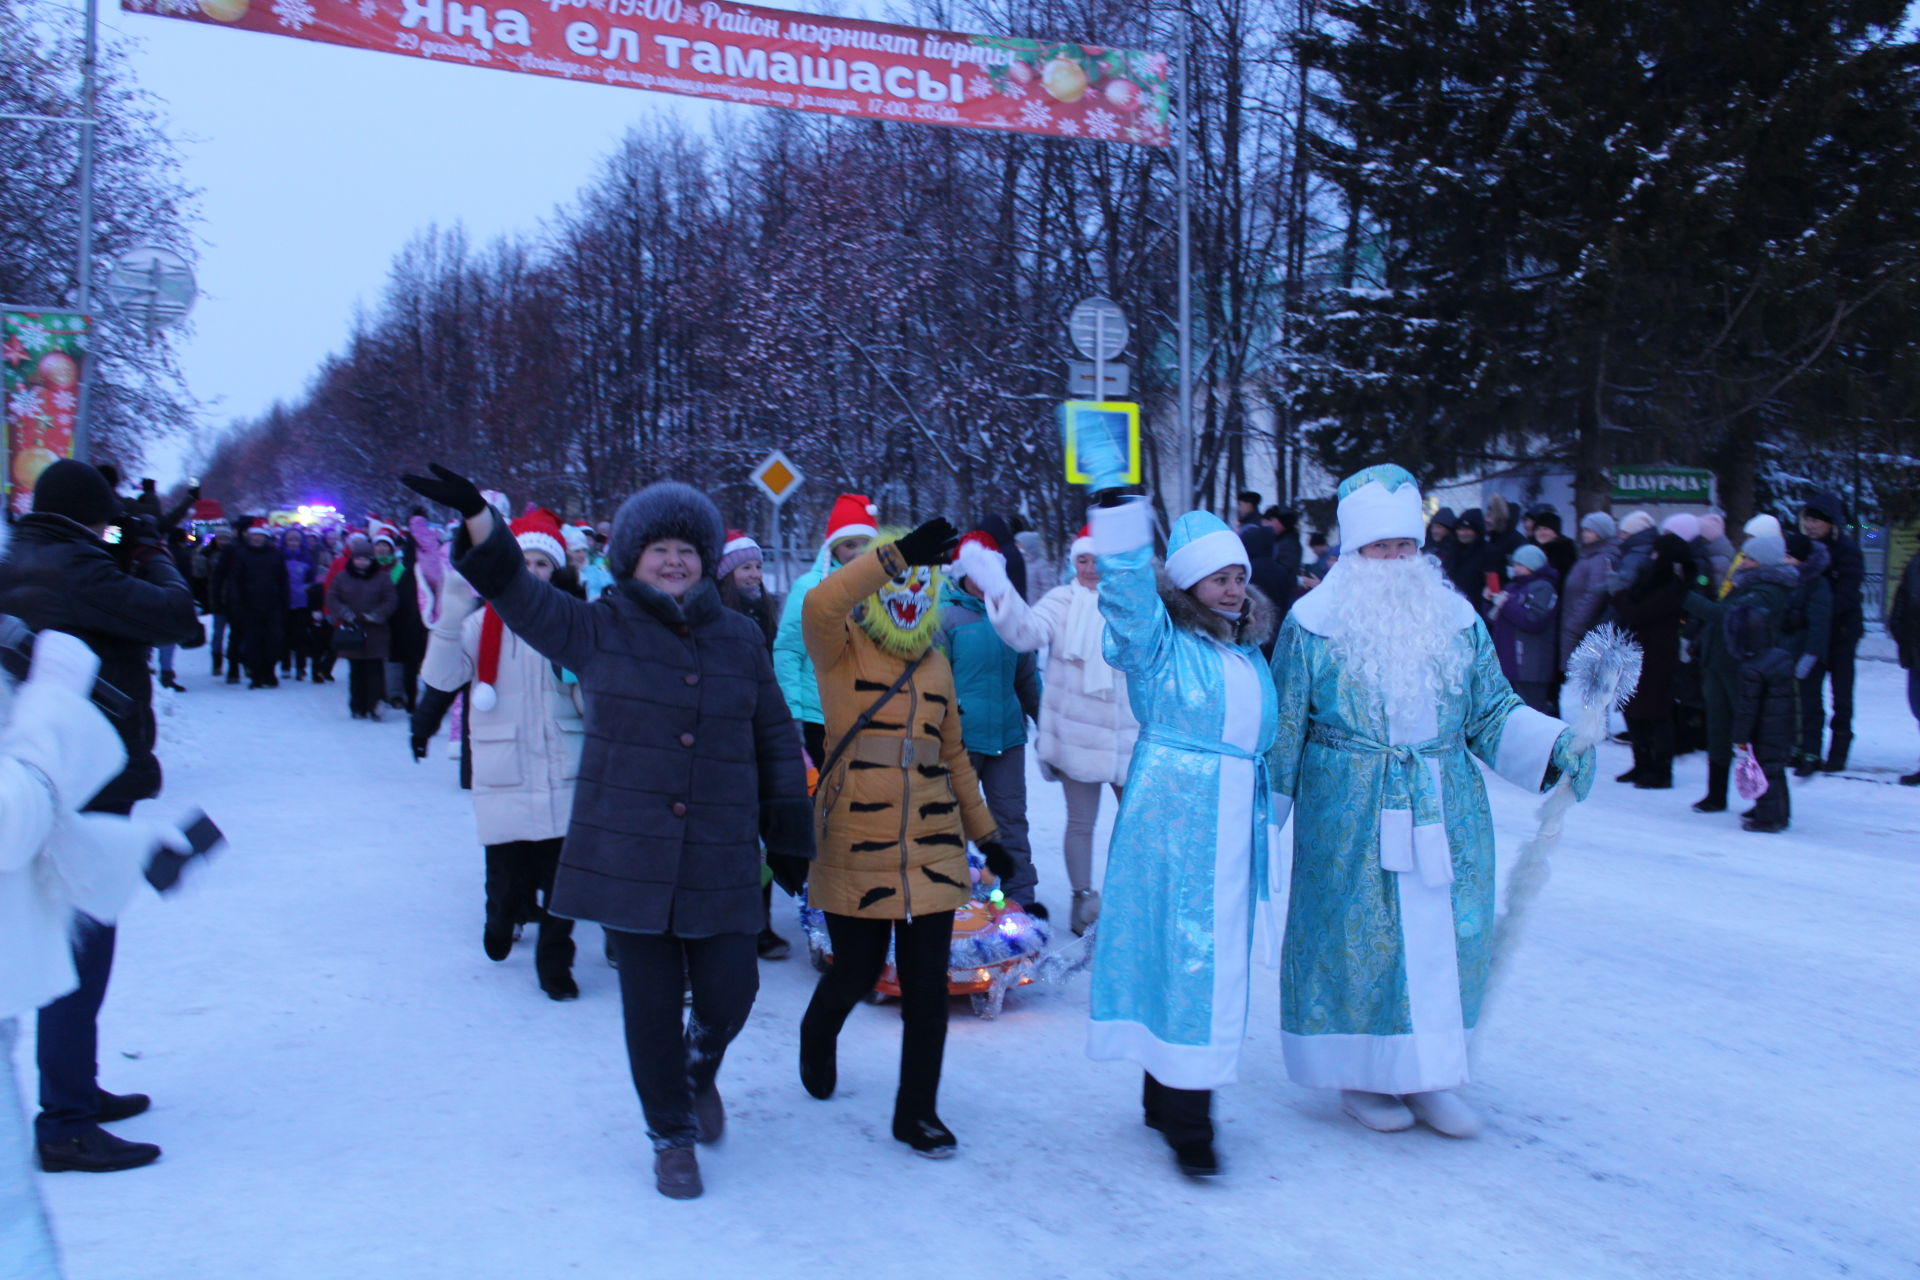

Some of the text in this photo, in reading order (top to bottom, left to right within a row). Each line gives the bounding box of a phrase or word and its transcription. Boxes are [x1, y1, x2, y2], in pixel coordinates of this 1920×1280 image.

[399, 0, 532, 50] Яңа
[565, 20, 640, 64] ел
[653, 33, 965, 104] тамашасы
[700, 1, 779, 39] Район
[783, 21, 919, 57] мәдәният
[923, 33, 1017, 68] йорты
